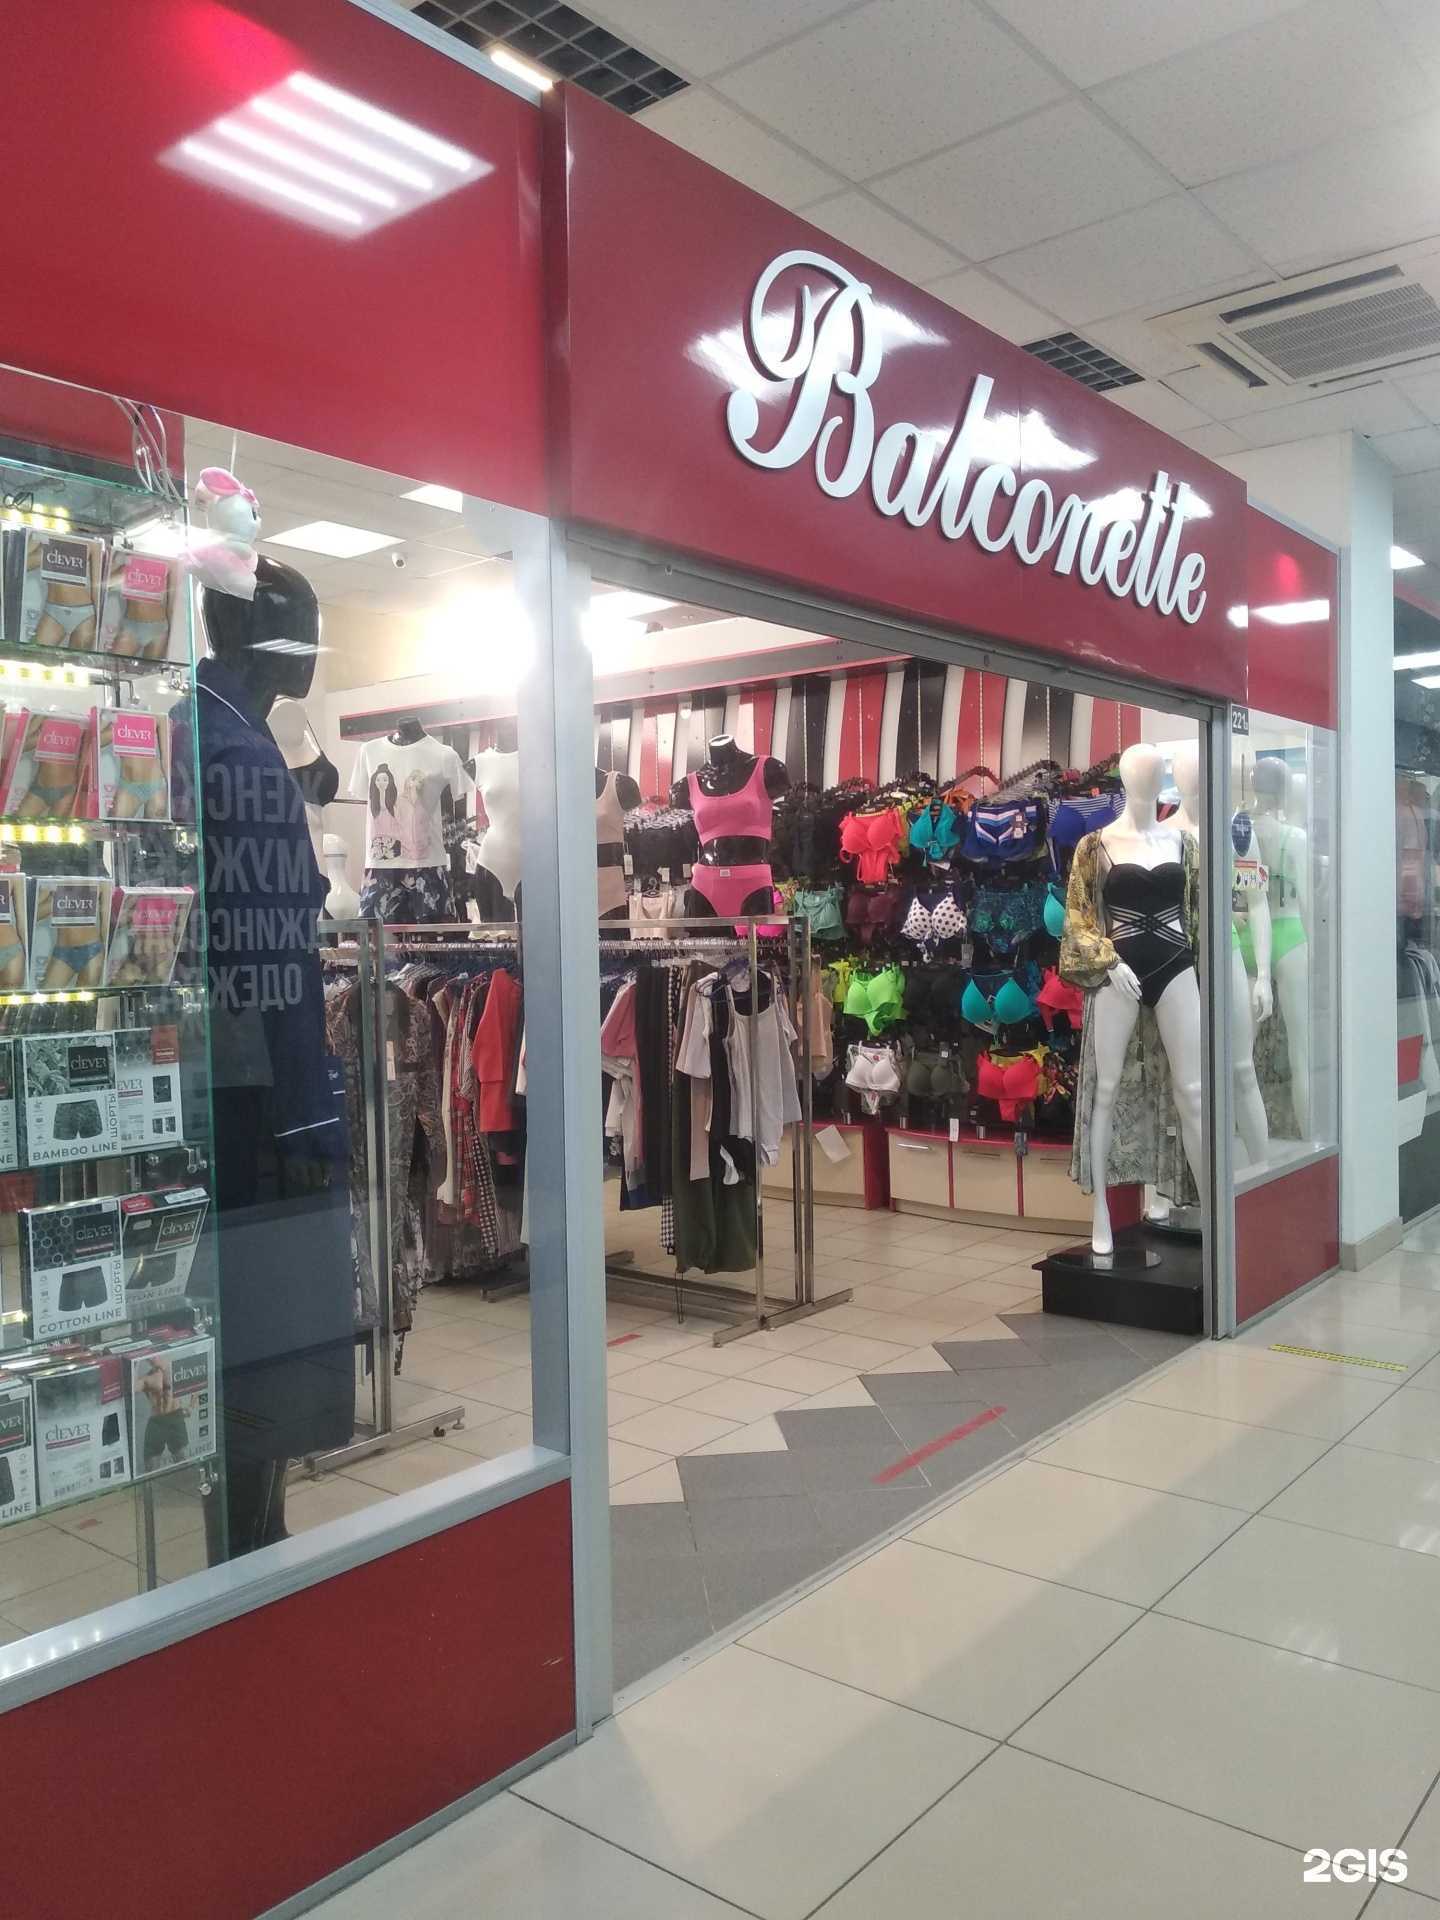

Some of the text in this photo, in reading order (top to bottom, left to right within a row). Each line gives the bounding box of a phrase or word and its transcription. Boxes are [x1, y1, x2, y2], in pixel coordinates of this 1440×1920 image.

[726, 249, 1206, 624] Balconette
[32, 1141, 118, 1162] BAMBOO LINE
[38, 1308, 122, 1335] COTTON LINE
[1, 1502, 32, 1519] LINE
